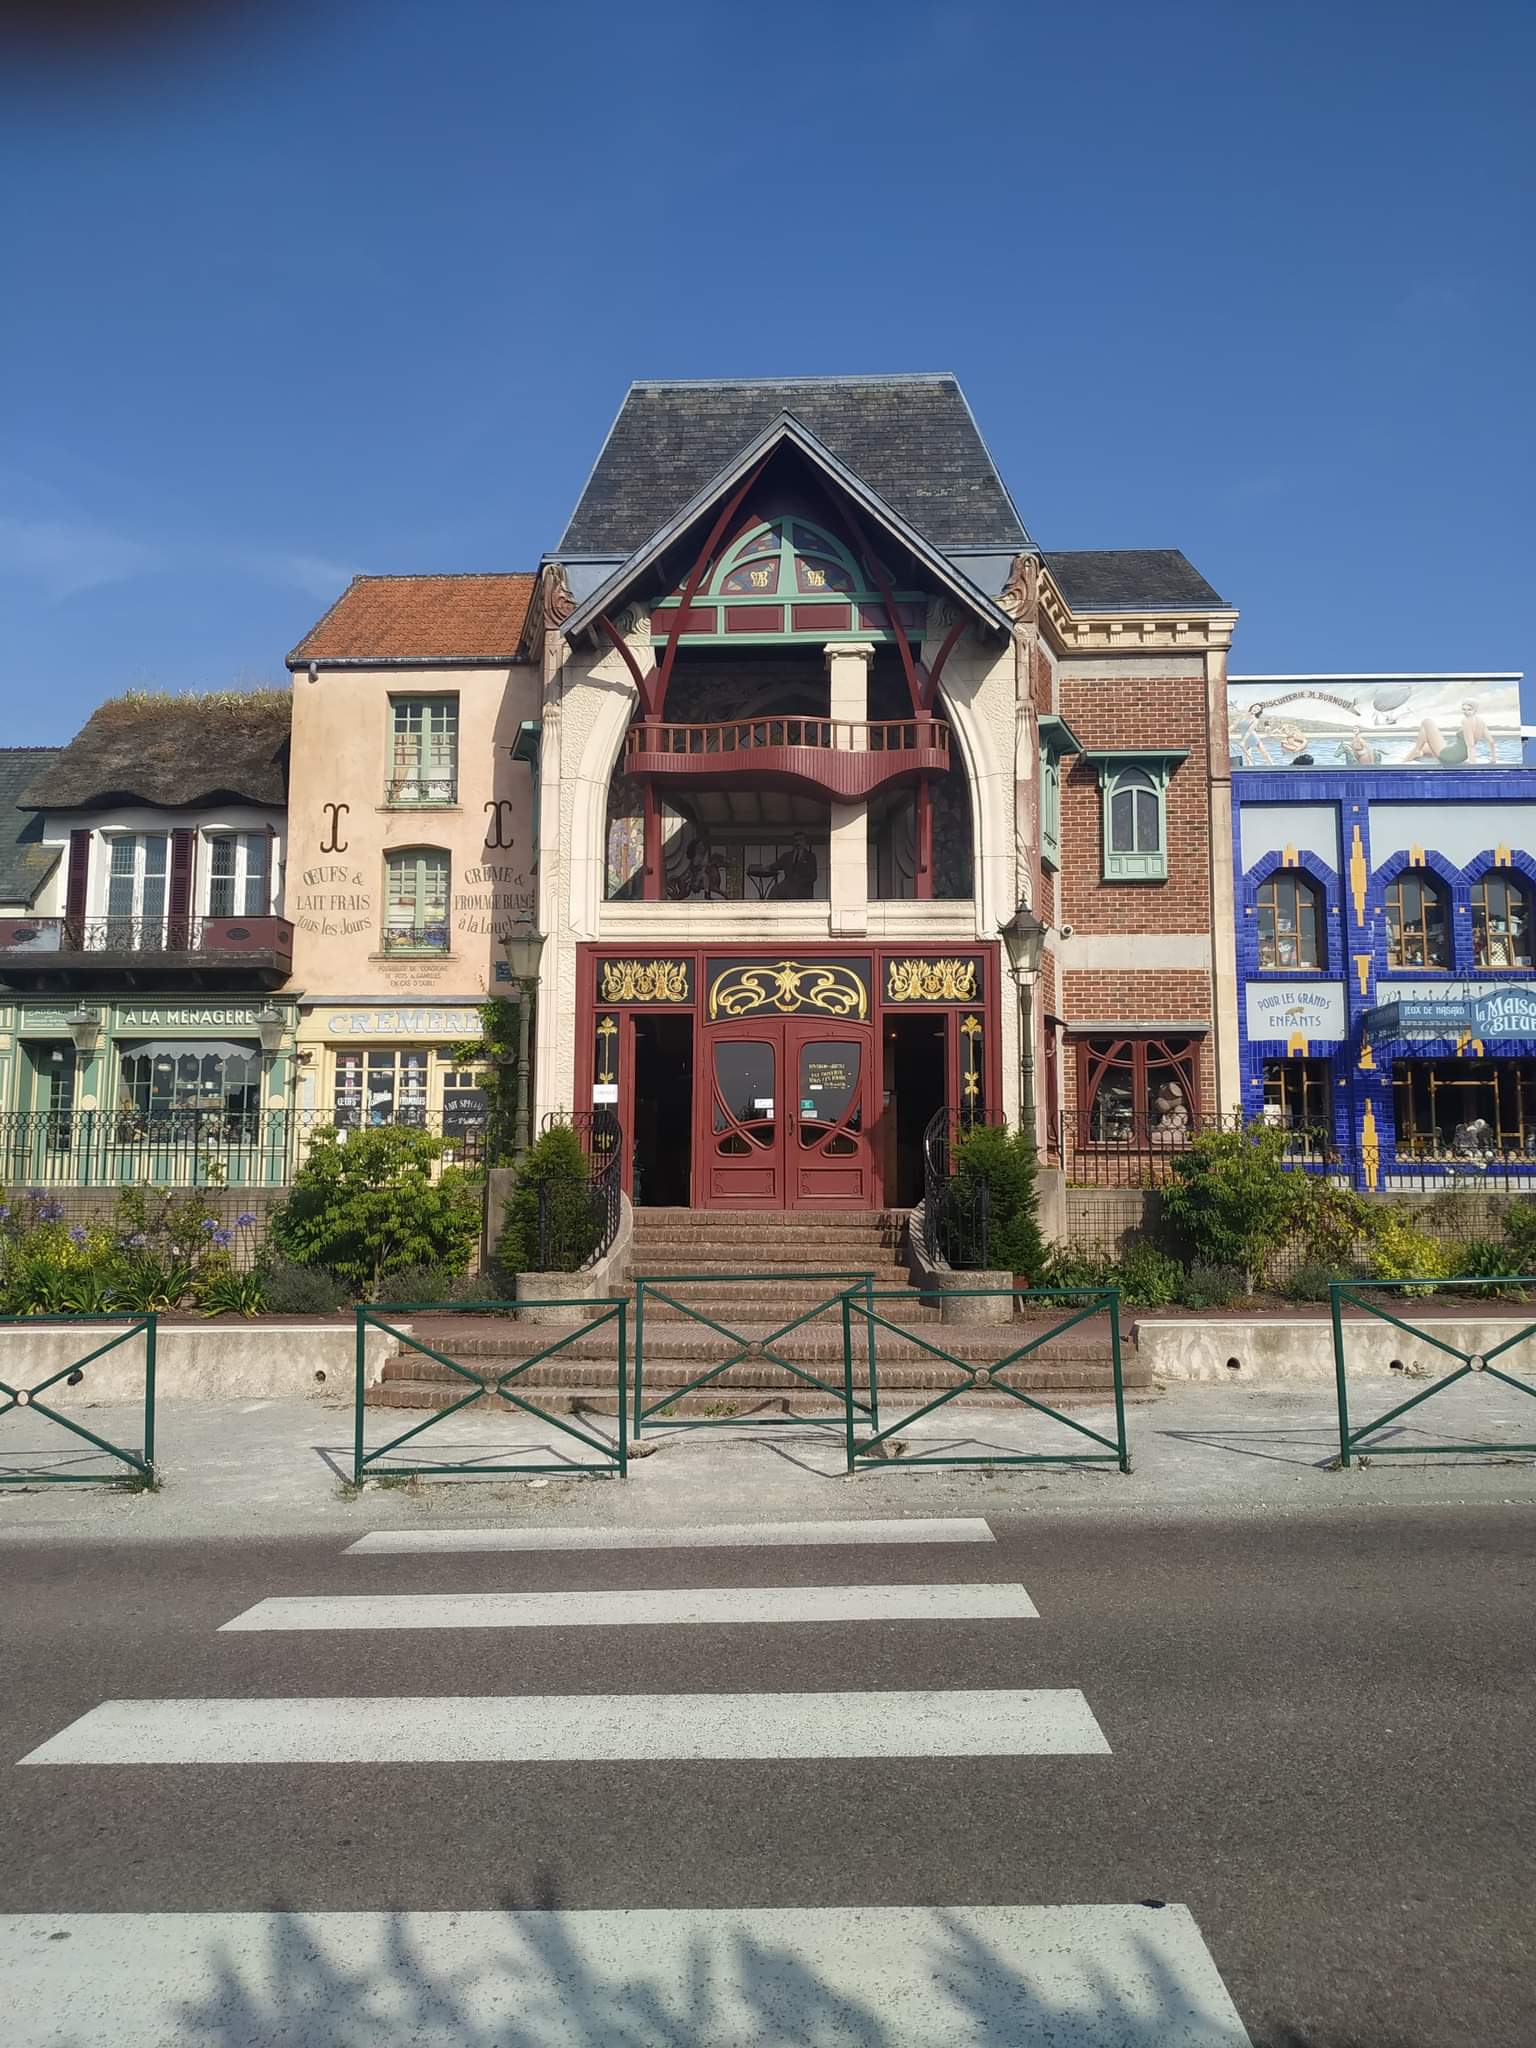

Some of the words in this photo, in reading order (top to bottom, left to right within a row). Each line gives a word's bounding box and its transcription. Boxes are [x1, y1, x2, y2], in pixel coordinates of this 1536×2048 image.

[352, 872, 365, 886] &
[514, 873, 526, 887] &
[296, 895, 326, 911] LAIT
[330, 895, 370, 911] FRAIS
[454, 895, 500, 911] FROMAGE
[321, 917, 338, 936] les
[467, 914, 478, 933] la
[1257, 995, 1280, 1011] POUR
[1281, 993, 1295, 1005] LES
[1297, 992, 1332, 1009] GRANDS
[140, 1008, 160, 1025] LA
[1423, 1006, 1432, 1014] DE
[1269, 1015, 1322, 1027] ENFANTS
